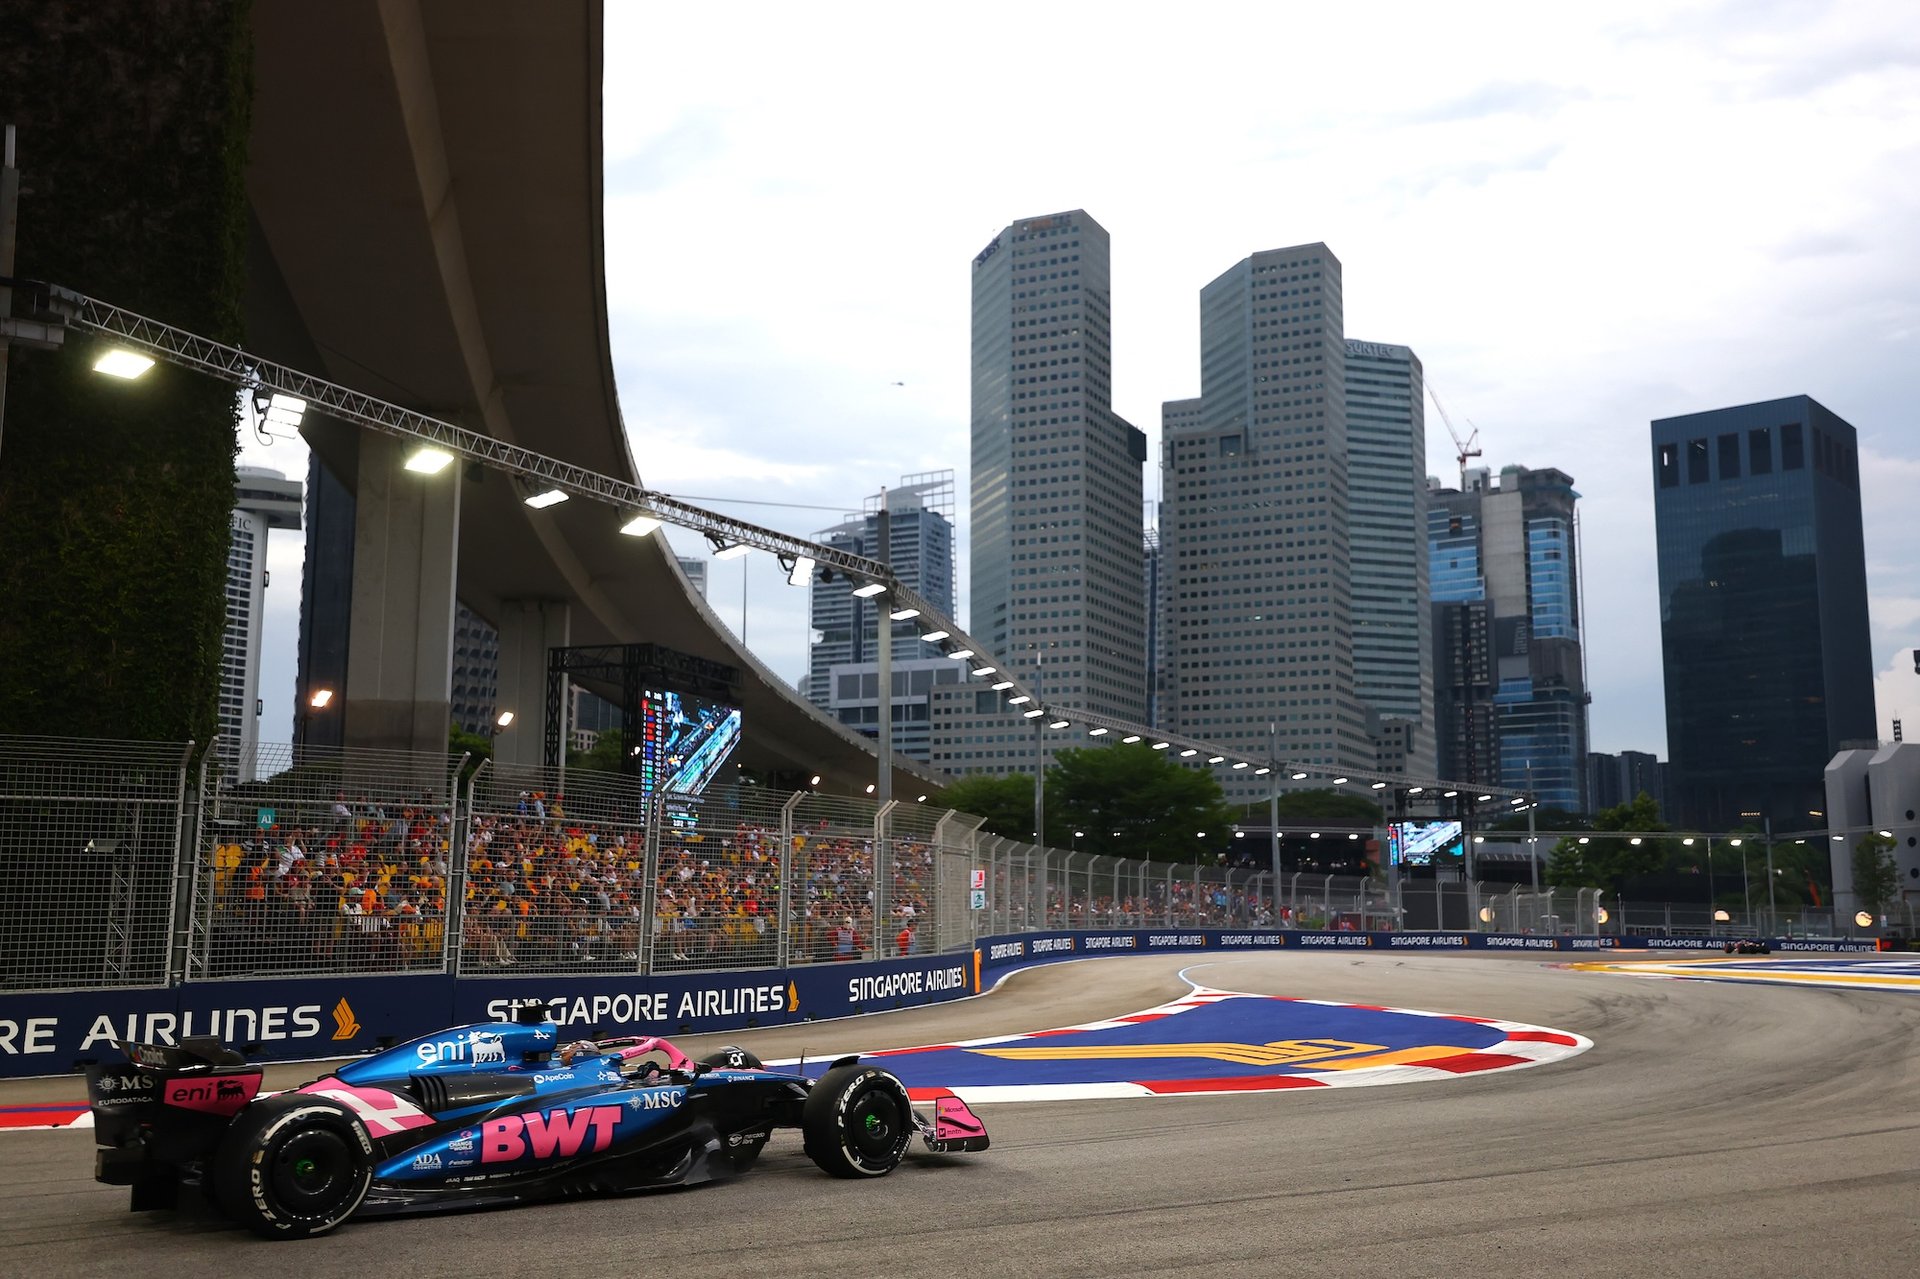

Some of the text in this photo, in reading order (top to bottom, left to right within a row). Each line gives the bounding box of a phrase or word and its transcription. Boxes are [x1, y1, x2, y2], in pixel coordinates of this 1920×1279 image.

[1345, 342, 1393, 358] SUNTEC
[1086, 936, 1133, 948] SINGAPORE AIRLINES
[1149, 936, 1201, 946] SINGAPORE AIRLINES
[1221, 935, 1279, 945] SINGAPORE AIRLINES
[1301, 936, 1366, 945] SINGAPORE AIRLINES
[1391, 936, 1462, 945] SINGAPORE AIRLINES
[1487, 938, 1553, 947] SINGAPORE AIRLINES
[1648, 939, 1702, 947] SINGAPORE
[1781, 942, 1835, 951] SINGAPORE
[849, 967, 962, 1002] SINGAPORE AIRLINES
[487, 986, 784, 1025] SIGAPORE AIRLINES
[79, 1005, 321, 1050] AIRLINES
[416, 1034, 464, 1064] eni
[121, 1075, 154, 1090] MS
[545, 1073, 574, 1082] ApeCoin
[173, 1083, 211, 1101] eni
[839, 1074, 865, 1113] ZERO
[644, 1091, 681, 1109] MSC
[482, 1106, 622, 1163] BWT
[413, 1153, 441, 1164] ADA
[252, 1169, 277, 1220] ZERO
